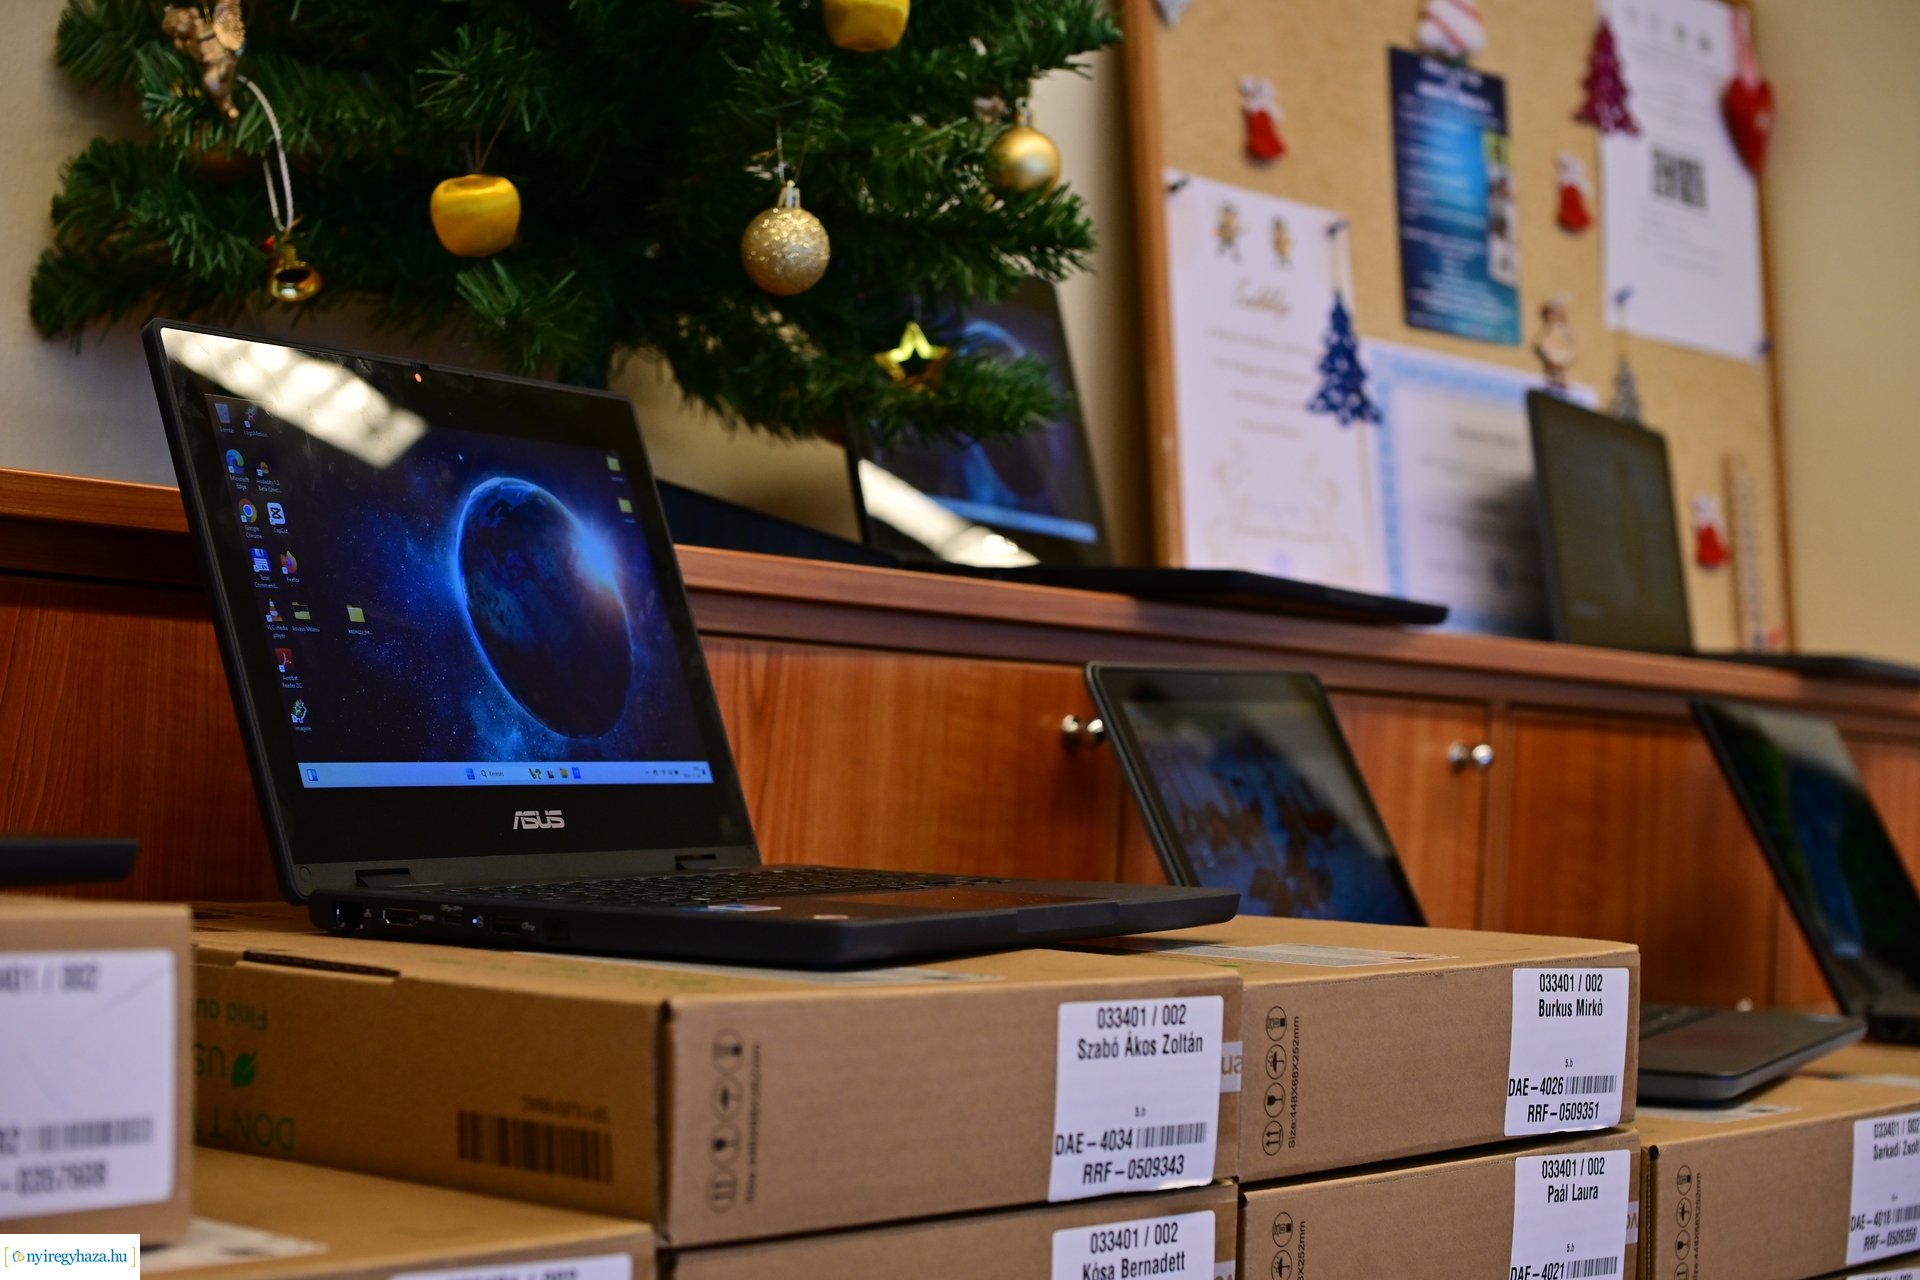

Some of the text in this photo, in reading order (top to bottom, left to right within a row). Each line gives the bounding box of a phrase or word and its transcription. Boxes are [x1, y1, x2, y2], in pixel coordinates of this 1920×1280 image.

[513, 809, 565, 830] ASUS
[1538, 974, 1575, 993] 033401
[1585, 973, 1604, 993] 002
[1096, 1006, 1147, 1030] 033401
[1161, 1004, 1188, 1026] 002
[1538, 998, 1604, 1018] Burkus Mirkó
[1077, 1031, 1204, 1060] Szabó Ákos Zoltán
[1542, 1159, 1577, 1179] 033401
[1587, 1156, 1605, 1176] 002
[1547, 1183, 1599, 1203] Paál Laura
[1090, 1228, 1139, 1254] 033401
[1154, 1222, 1179, 1245] 002
[1082, 1251, 1186, 1280] Kósa Bernadett
